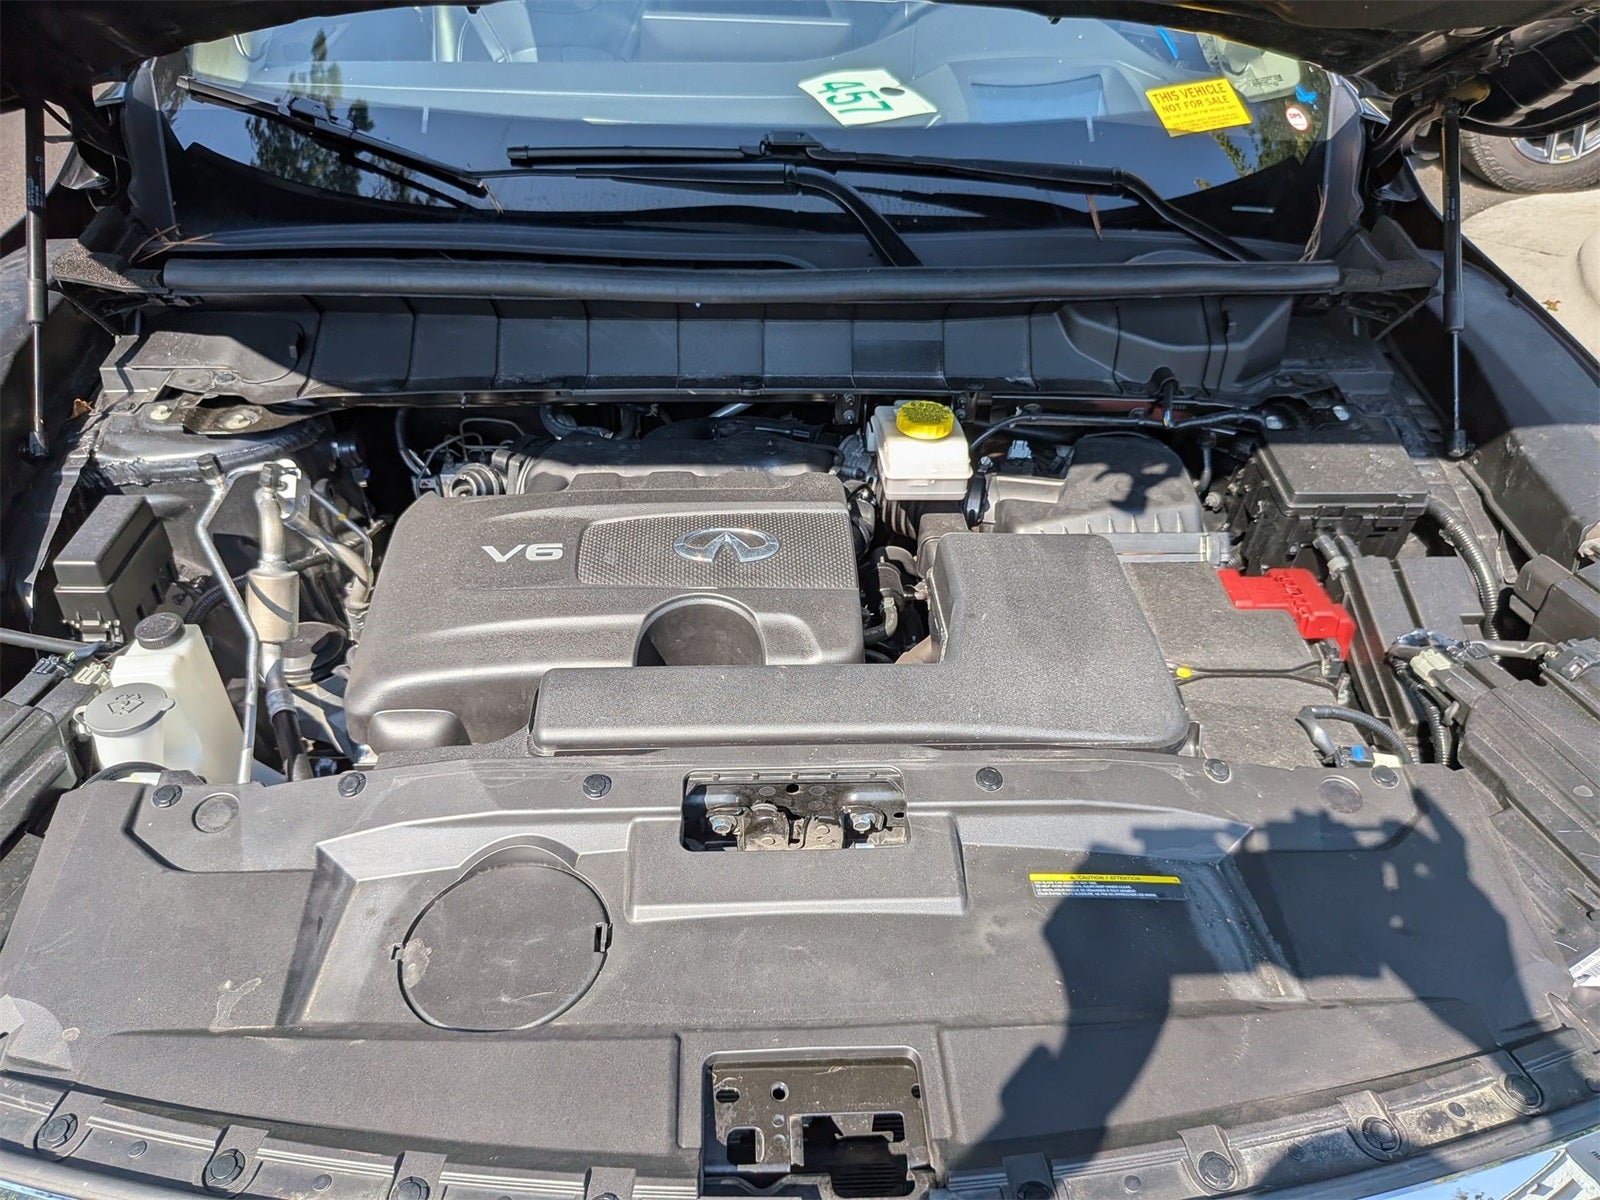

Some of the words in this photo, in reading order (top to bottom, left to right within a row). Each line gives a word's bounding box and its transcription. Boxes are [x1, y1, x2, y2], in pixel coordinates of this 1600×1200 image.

[817, 81, 894, 115] 457
[1152, 90, 1180, 105] THIS
[1180, 83, 1227, 99] VEHICLE
[1161, 103, 1182, 113] NOT
[1184, 100, 1205, 110] FOR
[1205, 95, 1230, 106] SALE
[481, 543, 563, 563] V6
